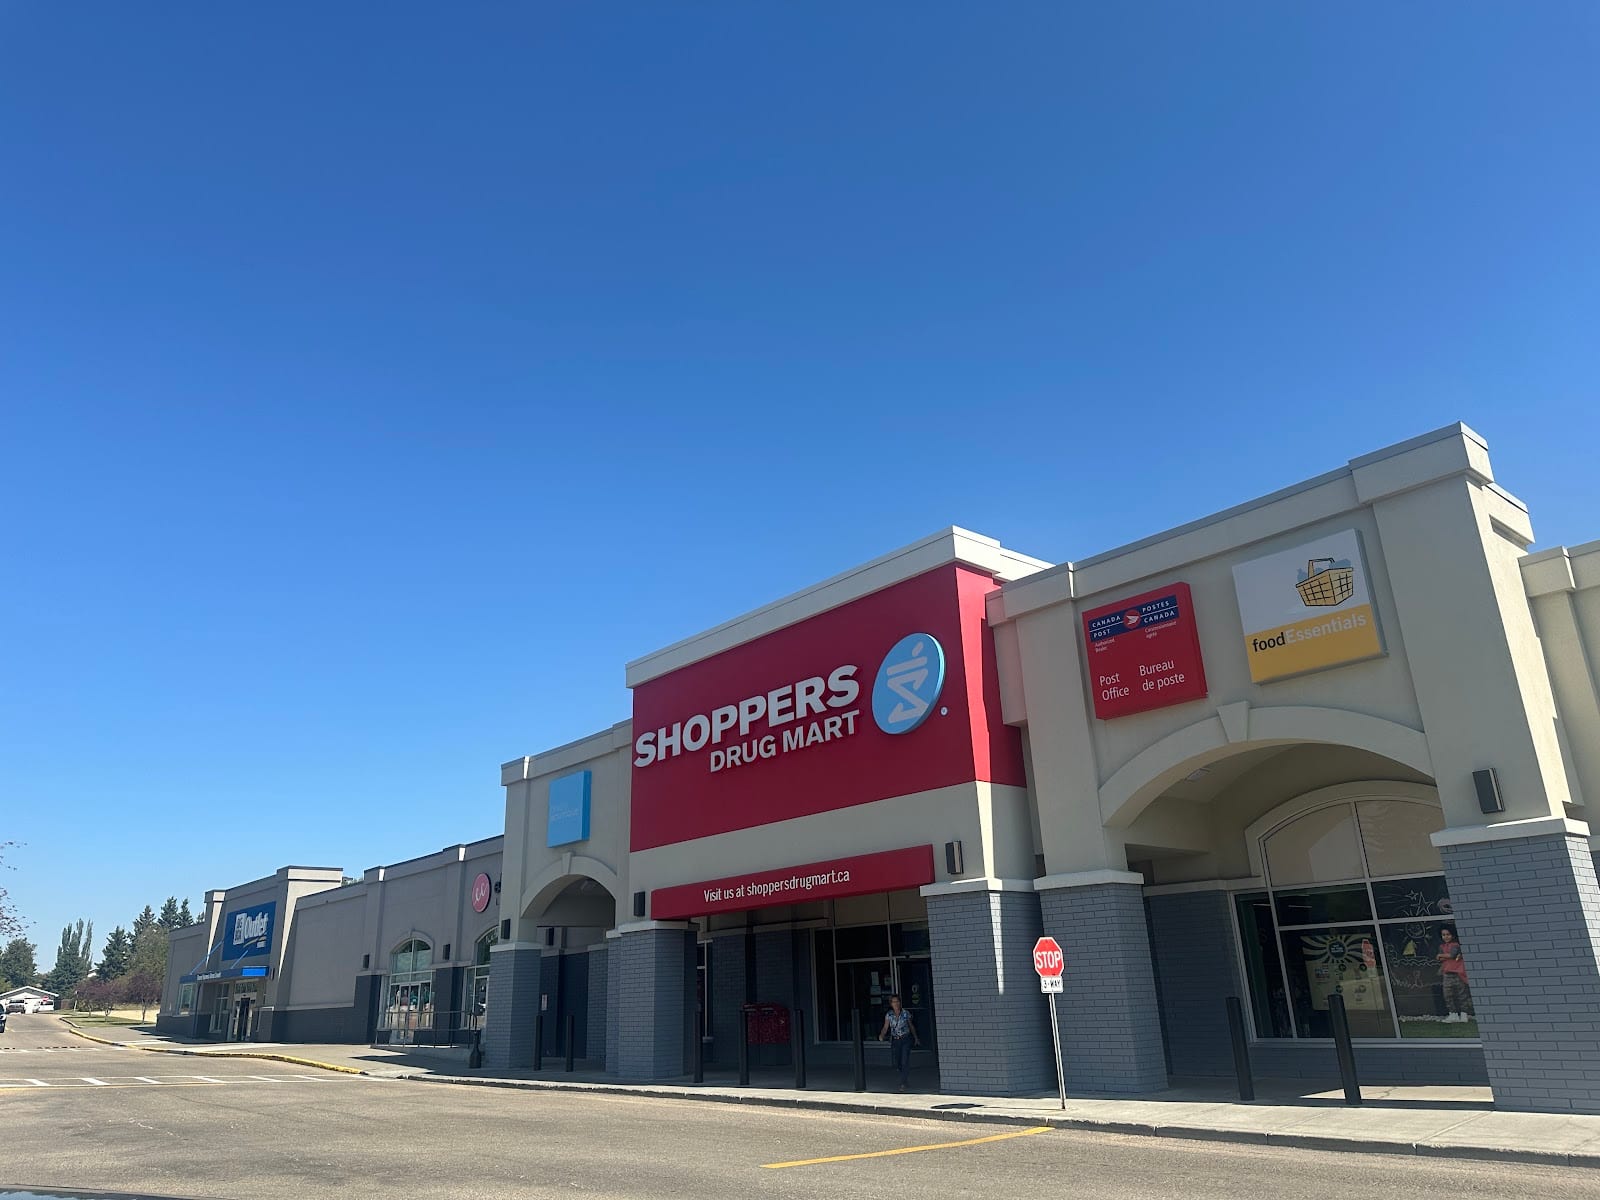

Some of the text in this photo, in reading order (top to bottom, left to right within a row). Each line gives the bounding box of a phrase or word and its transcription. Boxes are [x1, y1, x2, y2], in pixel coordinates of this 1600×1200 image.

[1142, 601, 1170, 613] POSTES
[1092, 615, 1121, 628] CANADA
[1143, 610, 1175, 623] CANADA
[1093, 628, 1111, 639] POST
[1138, 659, 1175, 677] Bureau
[1099, 673, 1120, 686] Post
[1142, 673, 1185, 691] de poste
[1102, 686, 1130, 701] Office
[634, 664, 860, 768] SHOPPERS
[710, 709, 860, 772] DRUG MART
[704, 869, 850, 903] Visit us at shoppersdrugmart.ca
[1036, 951, 1061, 969] STOP
